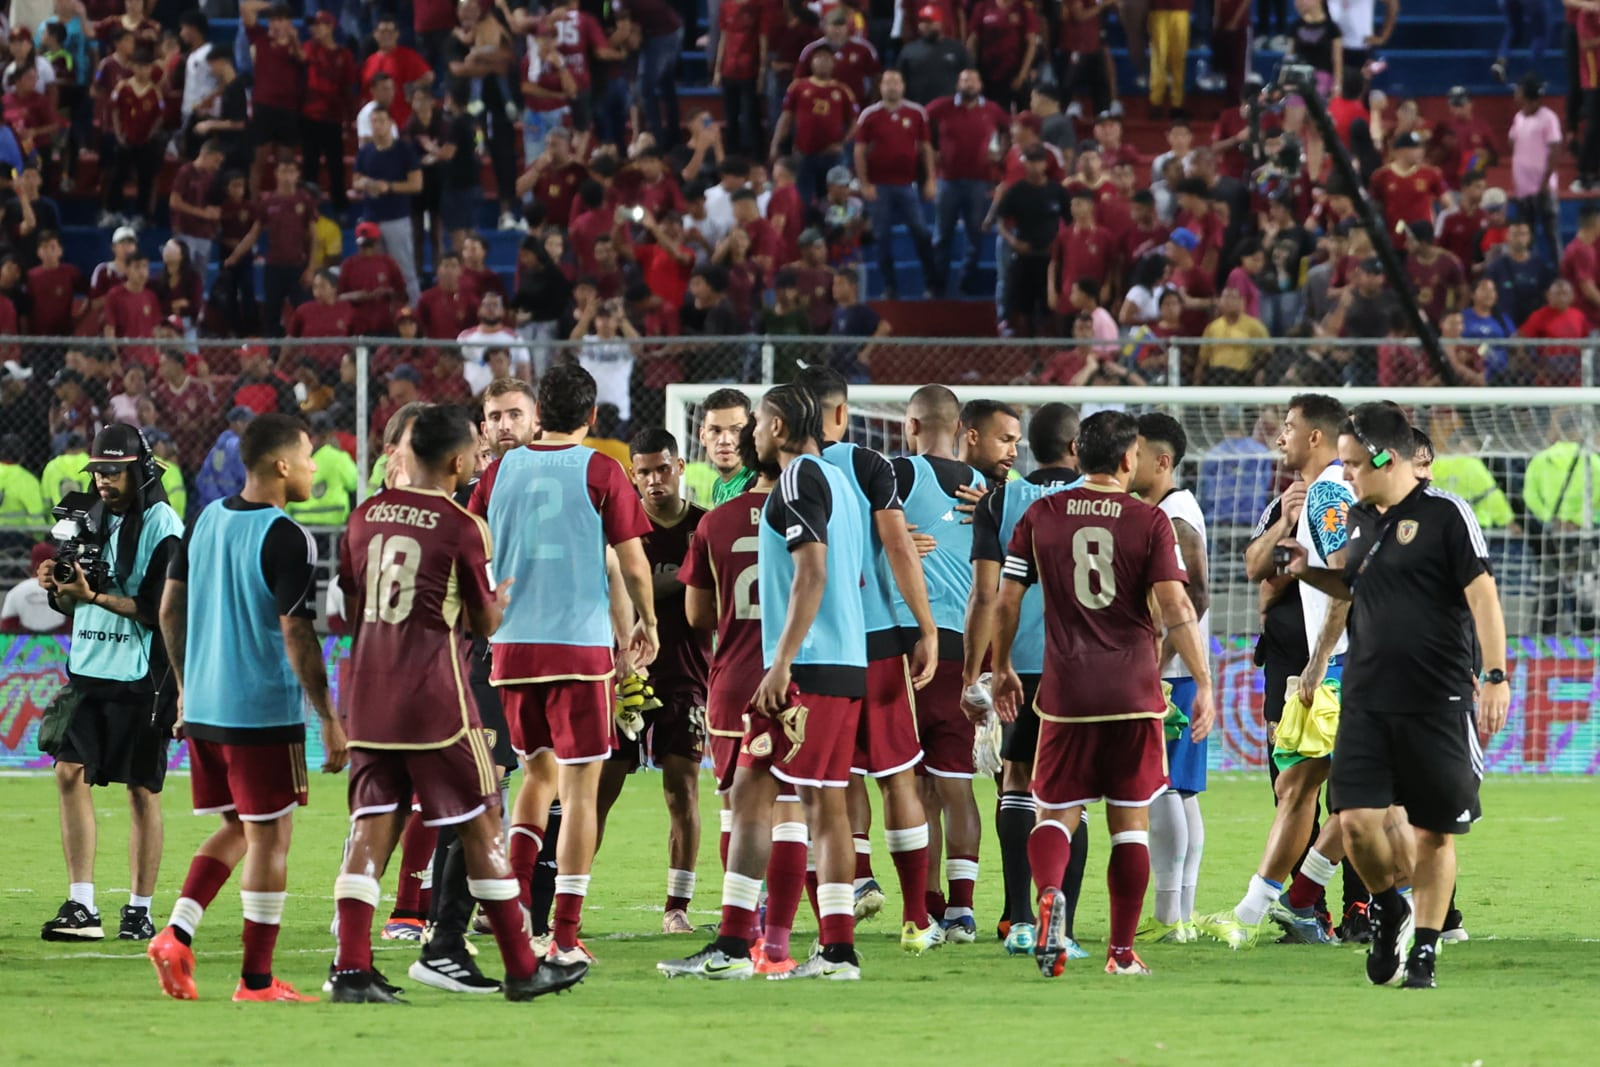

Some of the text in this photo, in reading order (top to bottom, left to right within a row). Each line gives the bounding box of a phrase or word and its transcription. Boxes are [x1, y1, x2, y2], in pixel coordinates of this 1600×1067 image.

[364, 501, 441, 530] CÁSSERES
[525, 477, 564, 560] 2
[1066, 498, 1122, 518] RINCÓN
[364, 532, 422, 625] 18
[1072, 526, 1117, 610] 8
[108, 631, 131, 643] FVF
